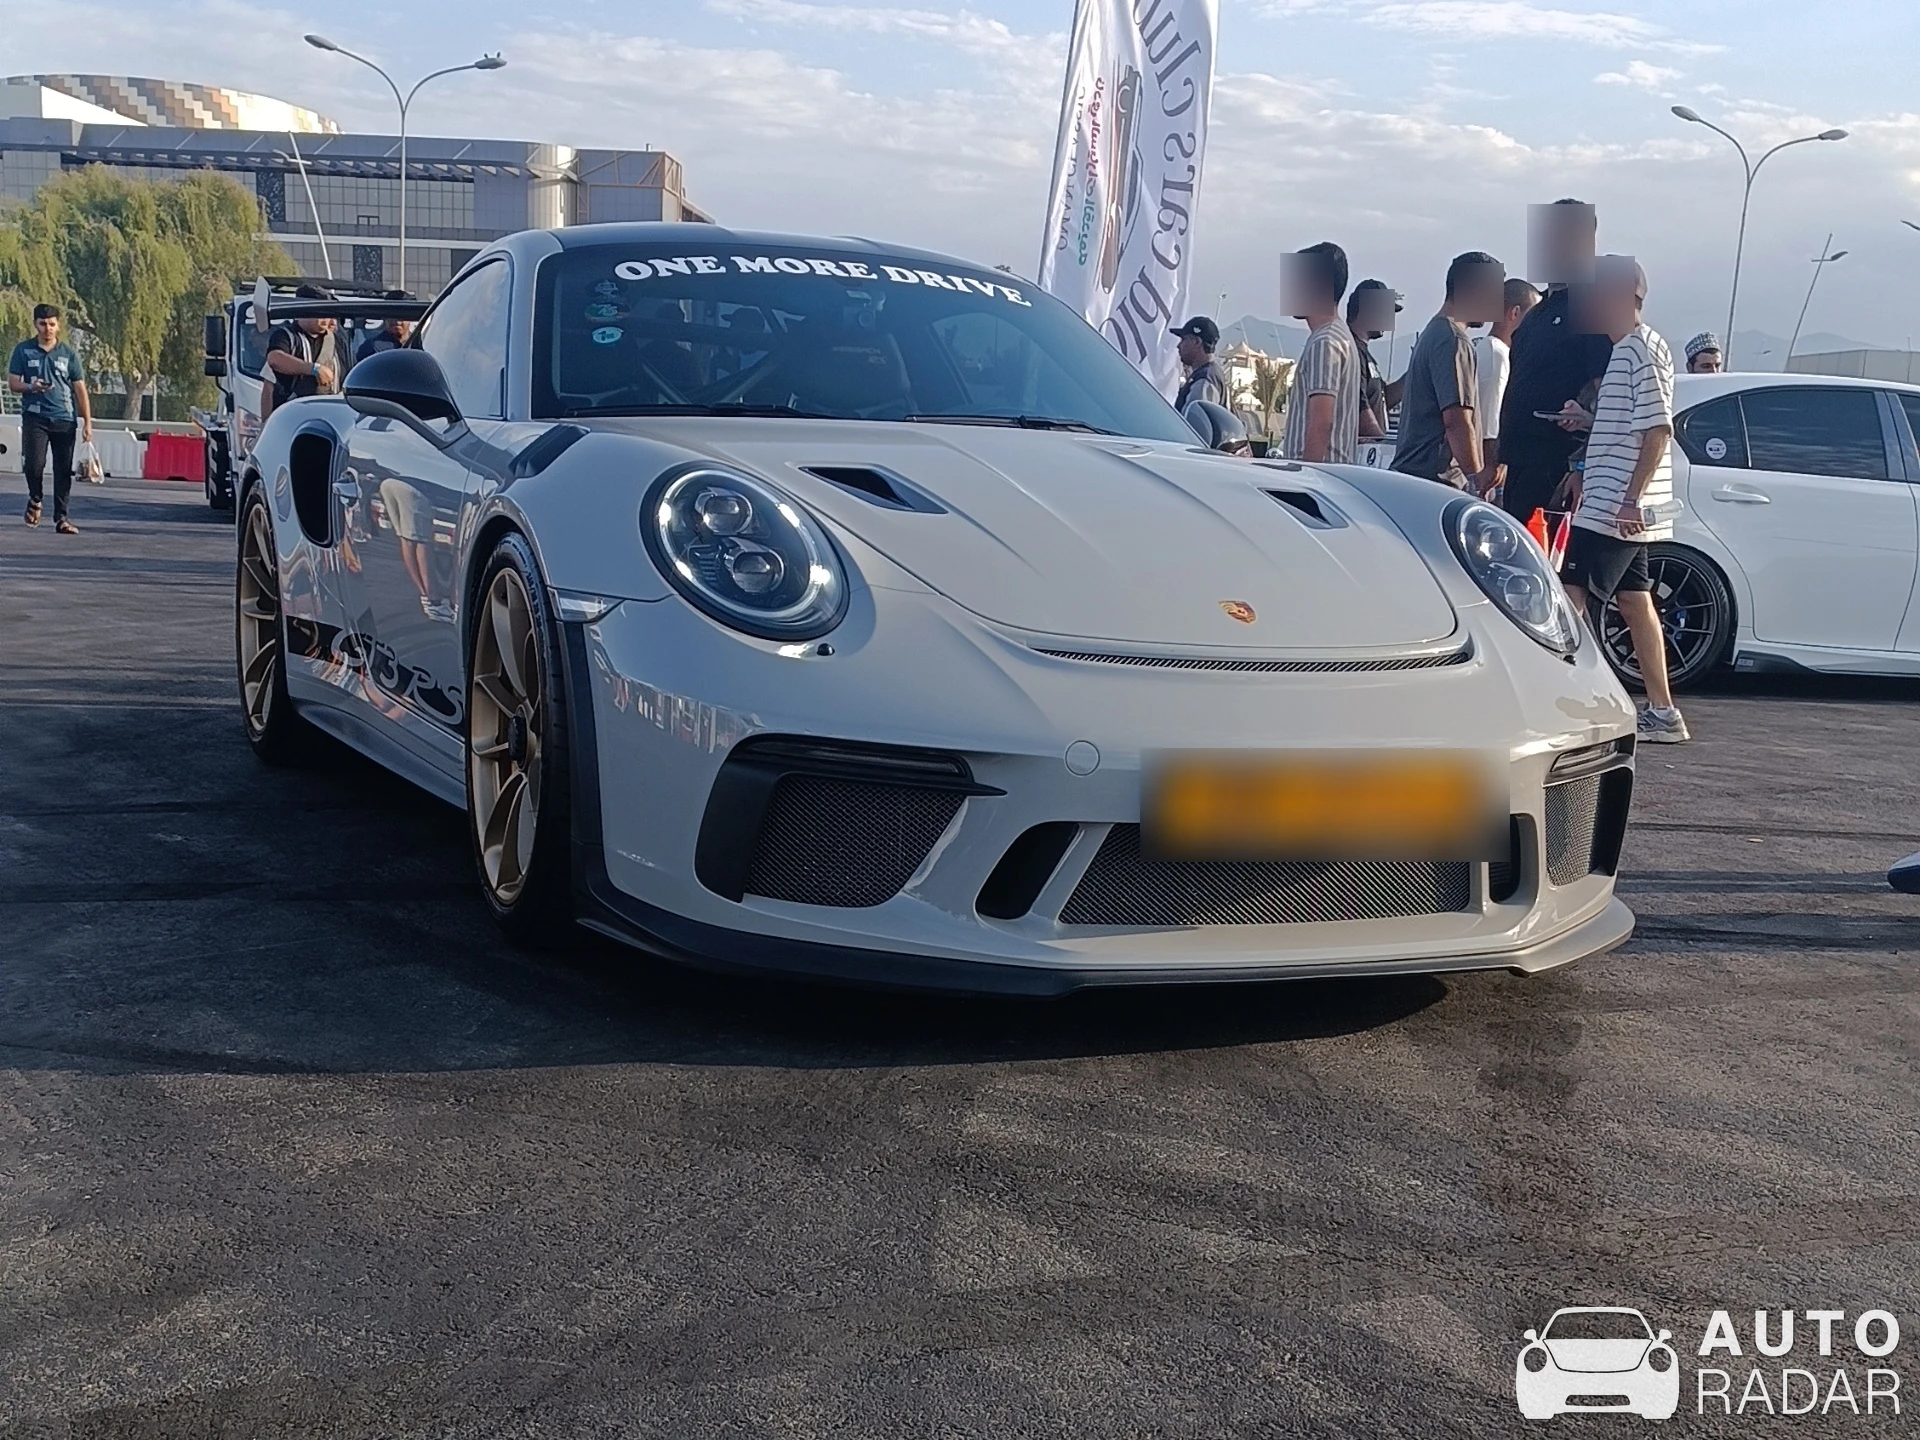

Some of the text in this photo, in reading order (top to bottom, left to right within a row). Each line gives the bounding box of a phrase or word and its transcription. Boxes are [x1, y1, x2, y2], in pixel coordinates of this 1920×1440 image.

[614, 256, 1032, 307] ONE MORE DRIVE
[402, 665, 463, 725] RS
